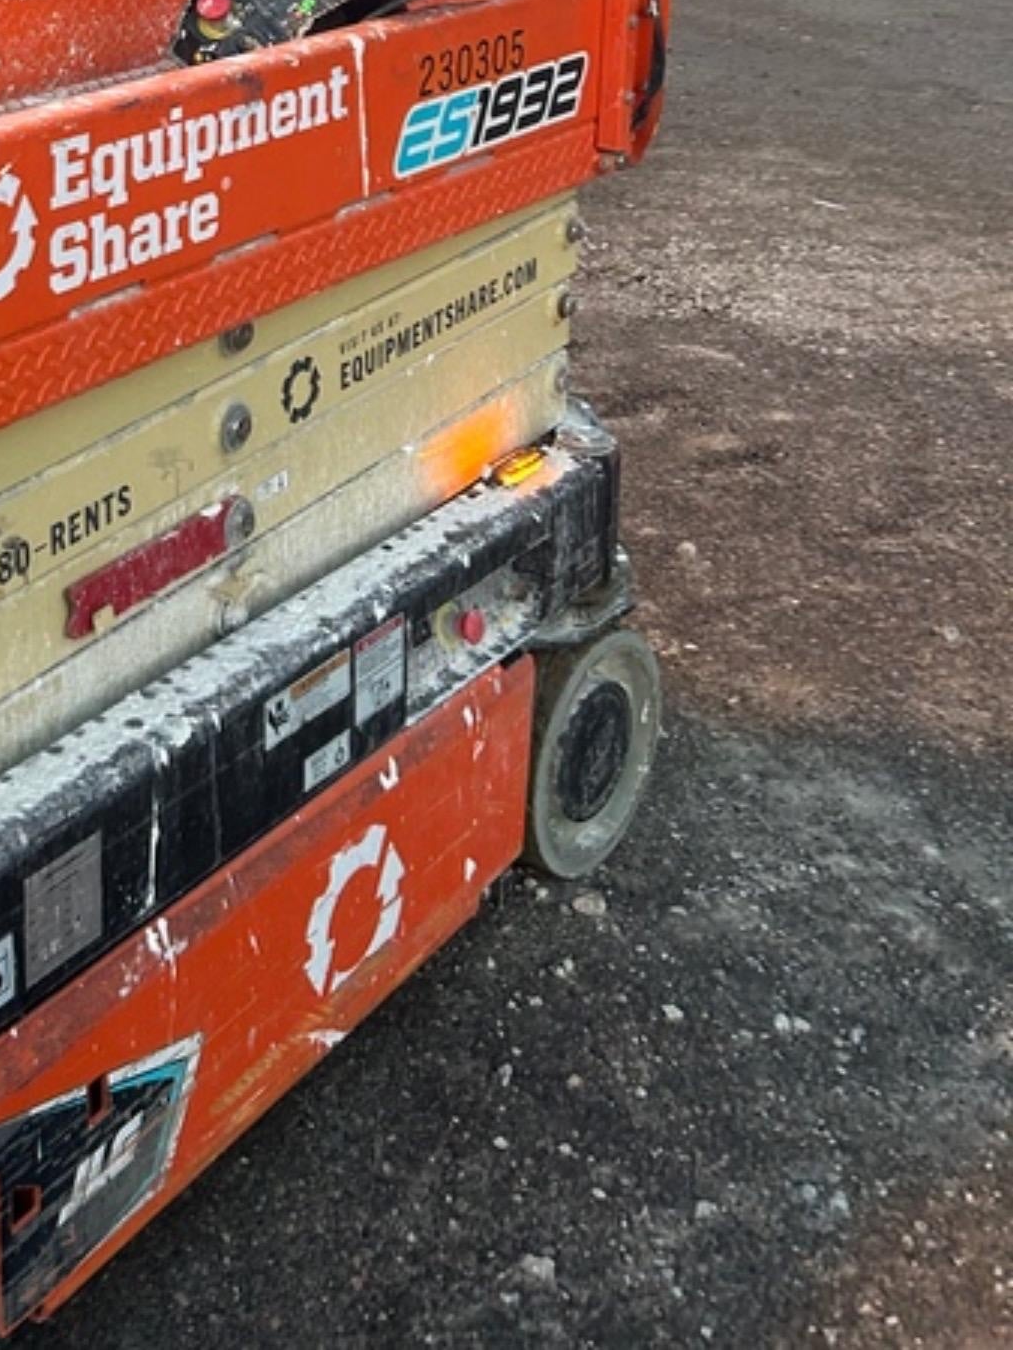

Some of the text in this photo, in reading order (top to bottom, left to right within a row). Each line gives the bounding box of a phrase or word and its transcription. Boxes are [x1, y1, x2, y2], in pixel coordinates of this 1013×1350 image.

[397, 56, 586, 176] ES1932
[420, 29, 525, 97] 230305
[50, 66, 348, 207] Equipment
[48, 193, 219, 295] Share
[340, 257, 538, 390] EQUIPMENTSHARE.COM
